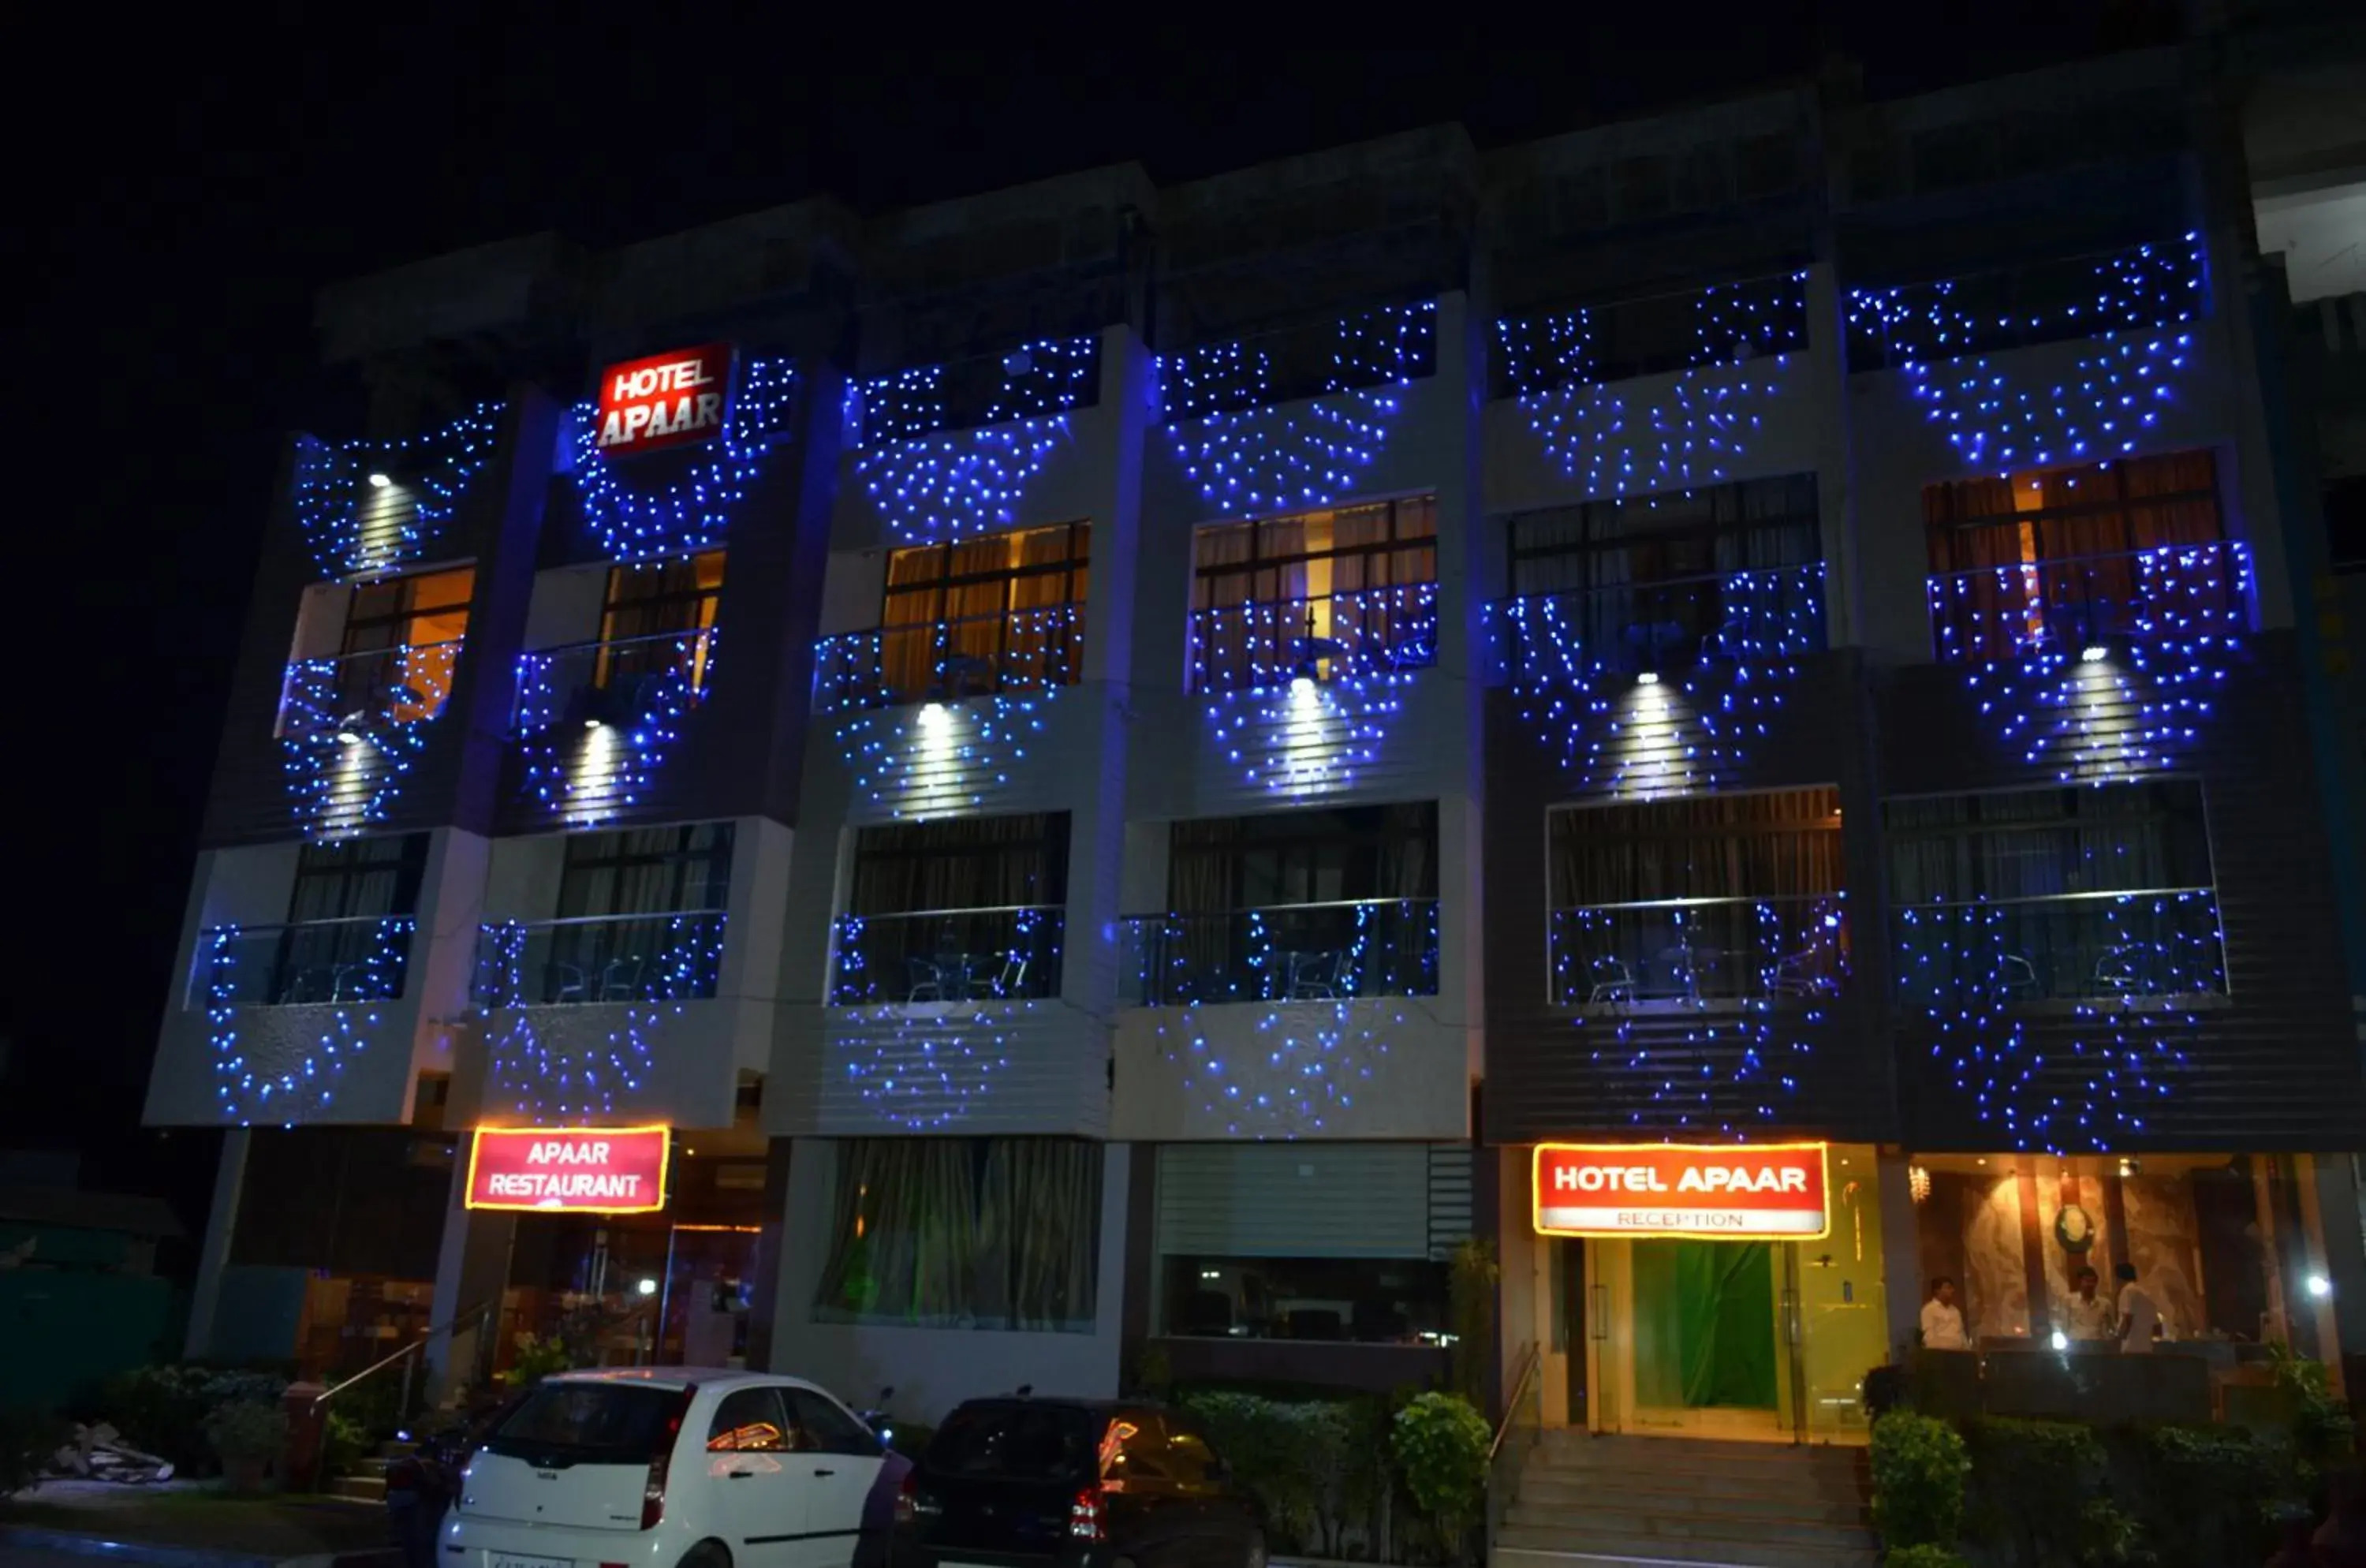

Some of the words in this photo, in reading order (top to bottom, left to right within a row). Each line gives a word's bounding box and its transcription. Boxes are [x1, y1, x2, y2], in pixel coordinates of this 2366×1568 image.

[614, 359, 714, 402] HOTEL
[597, 393, 720, 447] APAAR
[527, 1141, 610, 1164] APAAR
[489, 1173, 641, 1197] RESTAURANT
[1554, 1166, 1666, 1192] HOTEL
[1677, 1167, 1807, 1193] APAAR
[1618, 1211, 1743, 1227] RECEPTION
